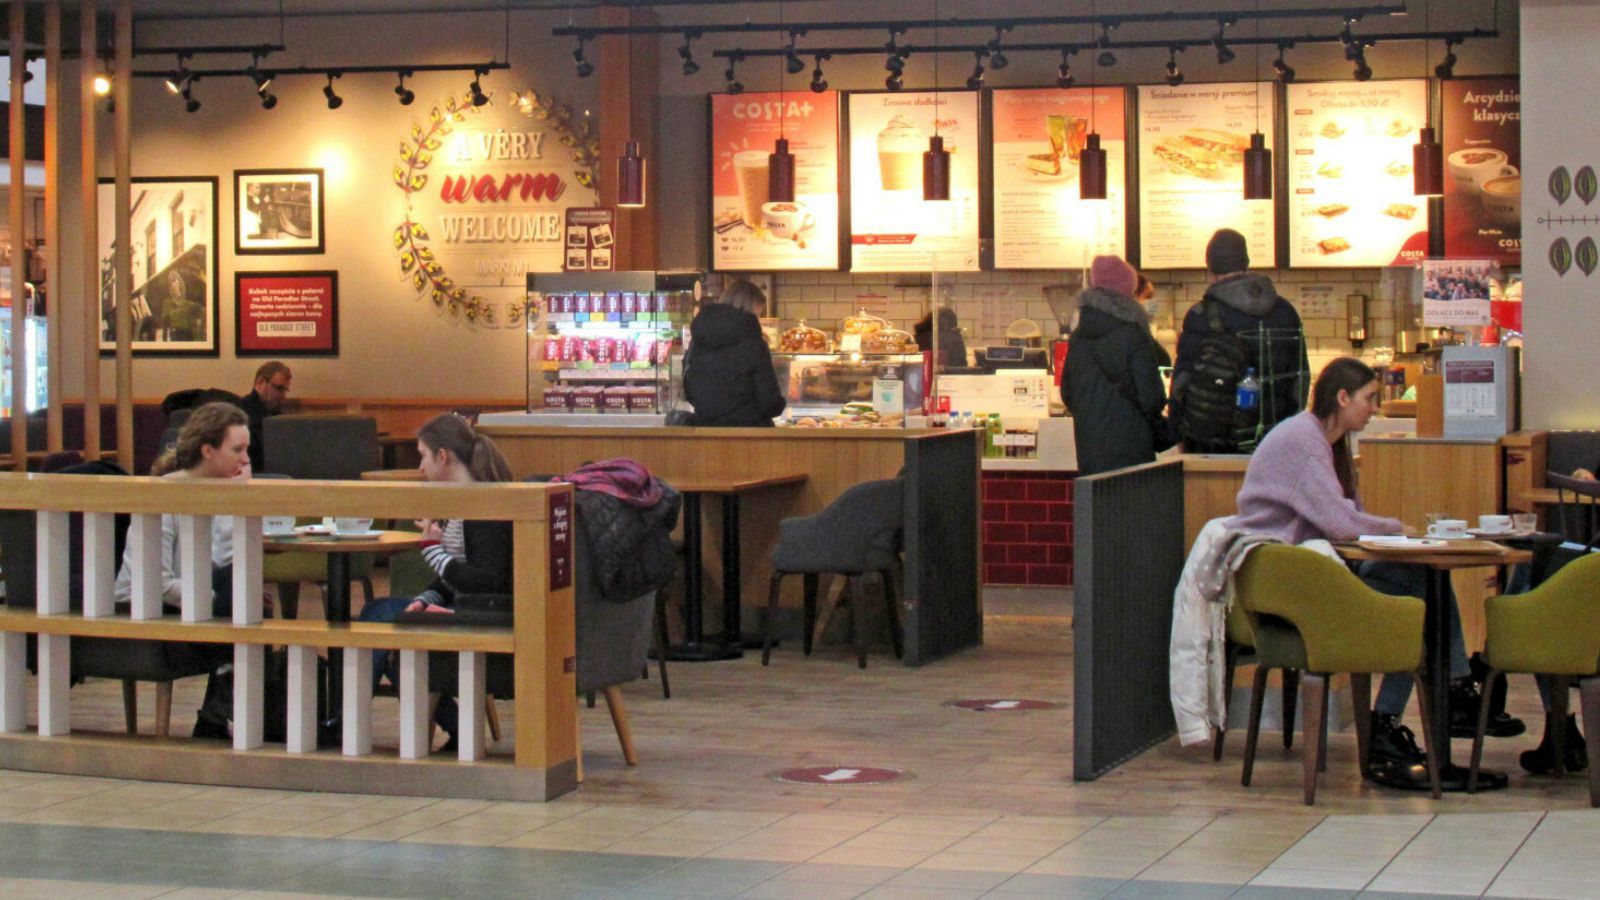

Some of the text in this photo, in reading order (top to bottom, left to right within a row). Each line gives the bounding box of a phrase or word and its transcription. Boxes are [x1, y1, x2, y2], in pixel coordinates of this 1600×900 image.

[479, 132, 545, 160] VERY
[440, 173, 566, 203] warm
[440, 213, 561, 242] WELCOME
